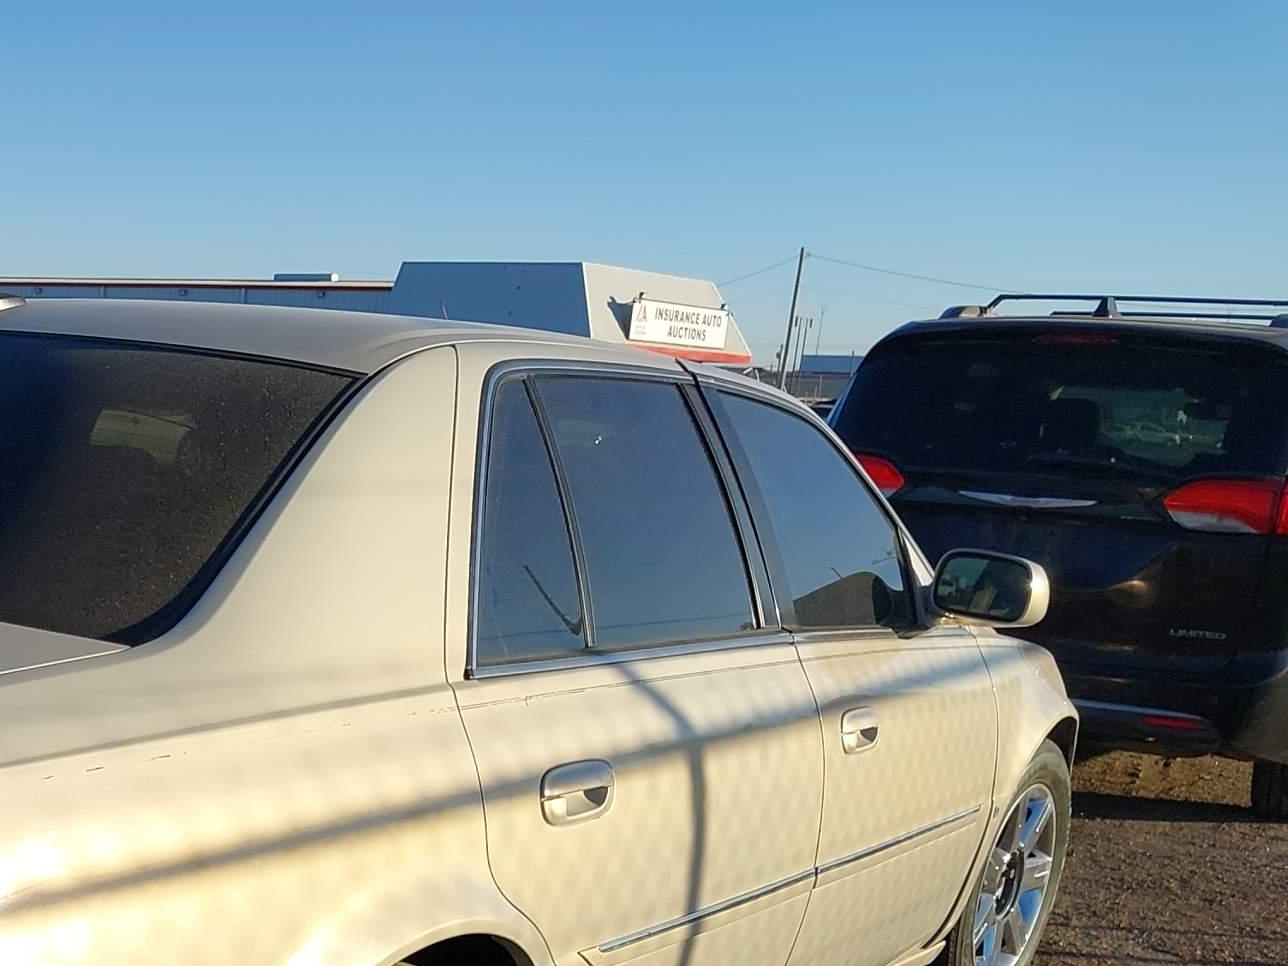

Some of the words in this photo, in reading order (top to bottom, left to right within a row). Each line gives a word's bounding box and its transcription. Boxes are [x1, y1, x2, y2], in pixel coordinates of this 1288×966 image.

[654, 307, 700, 326] INSURANCE
[702, 313, 722, 328] AUTO
[667, 325, 707, 342] AUCTIONS
[1170, 628, 1227, 640] LIMITED
